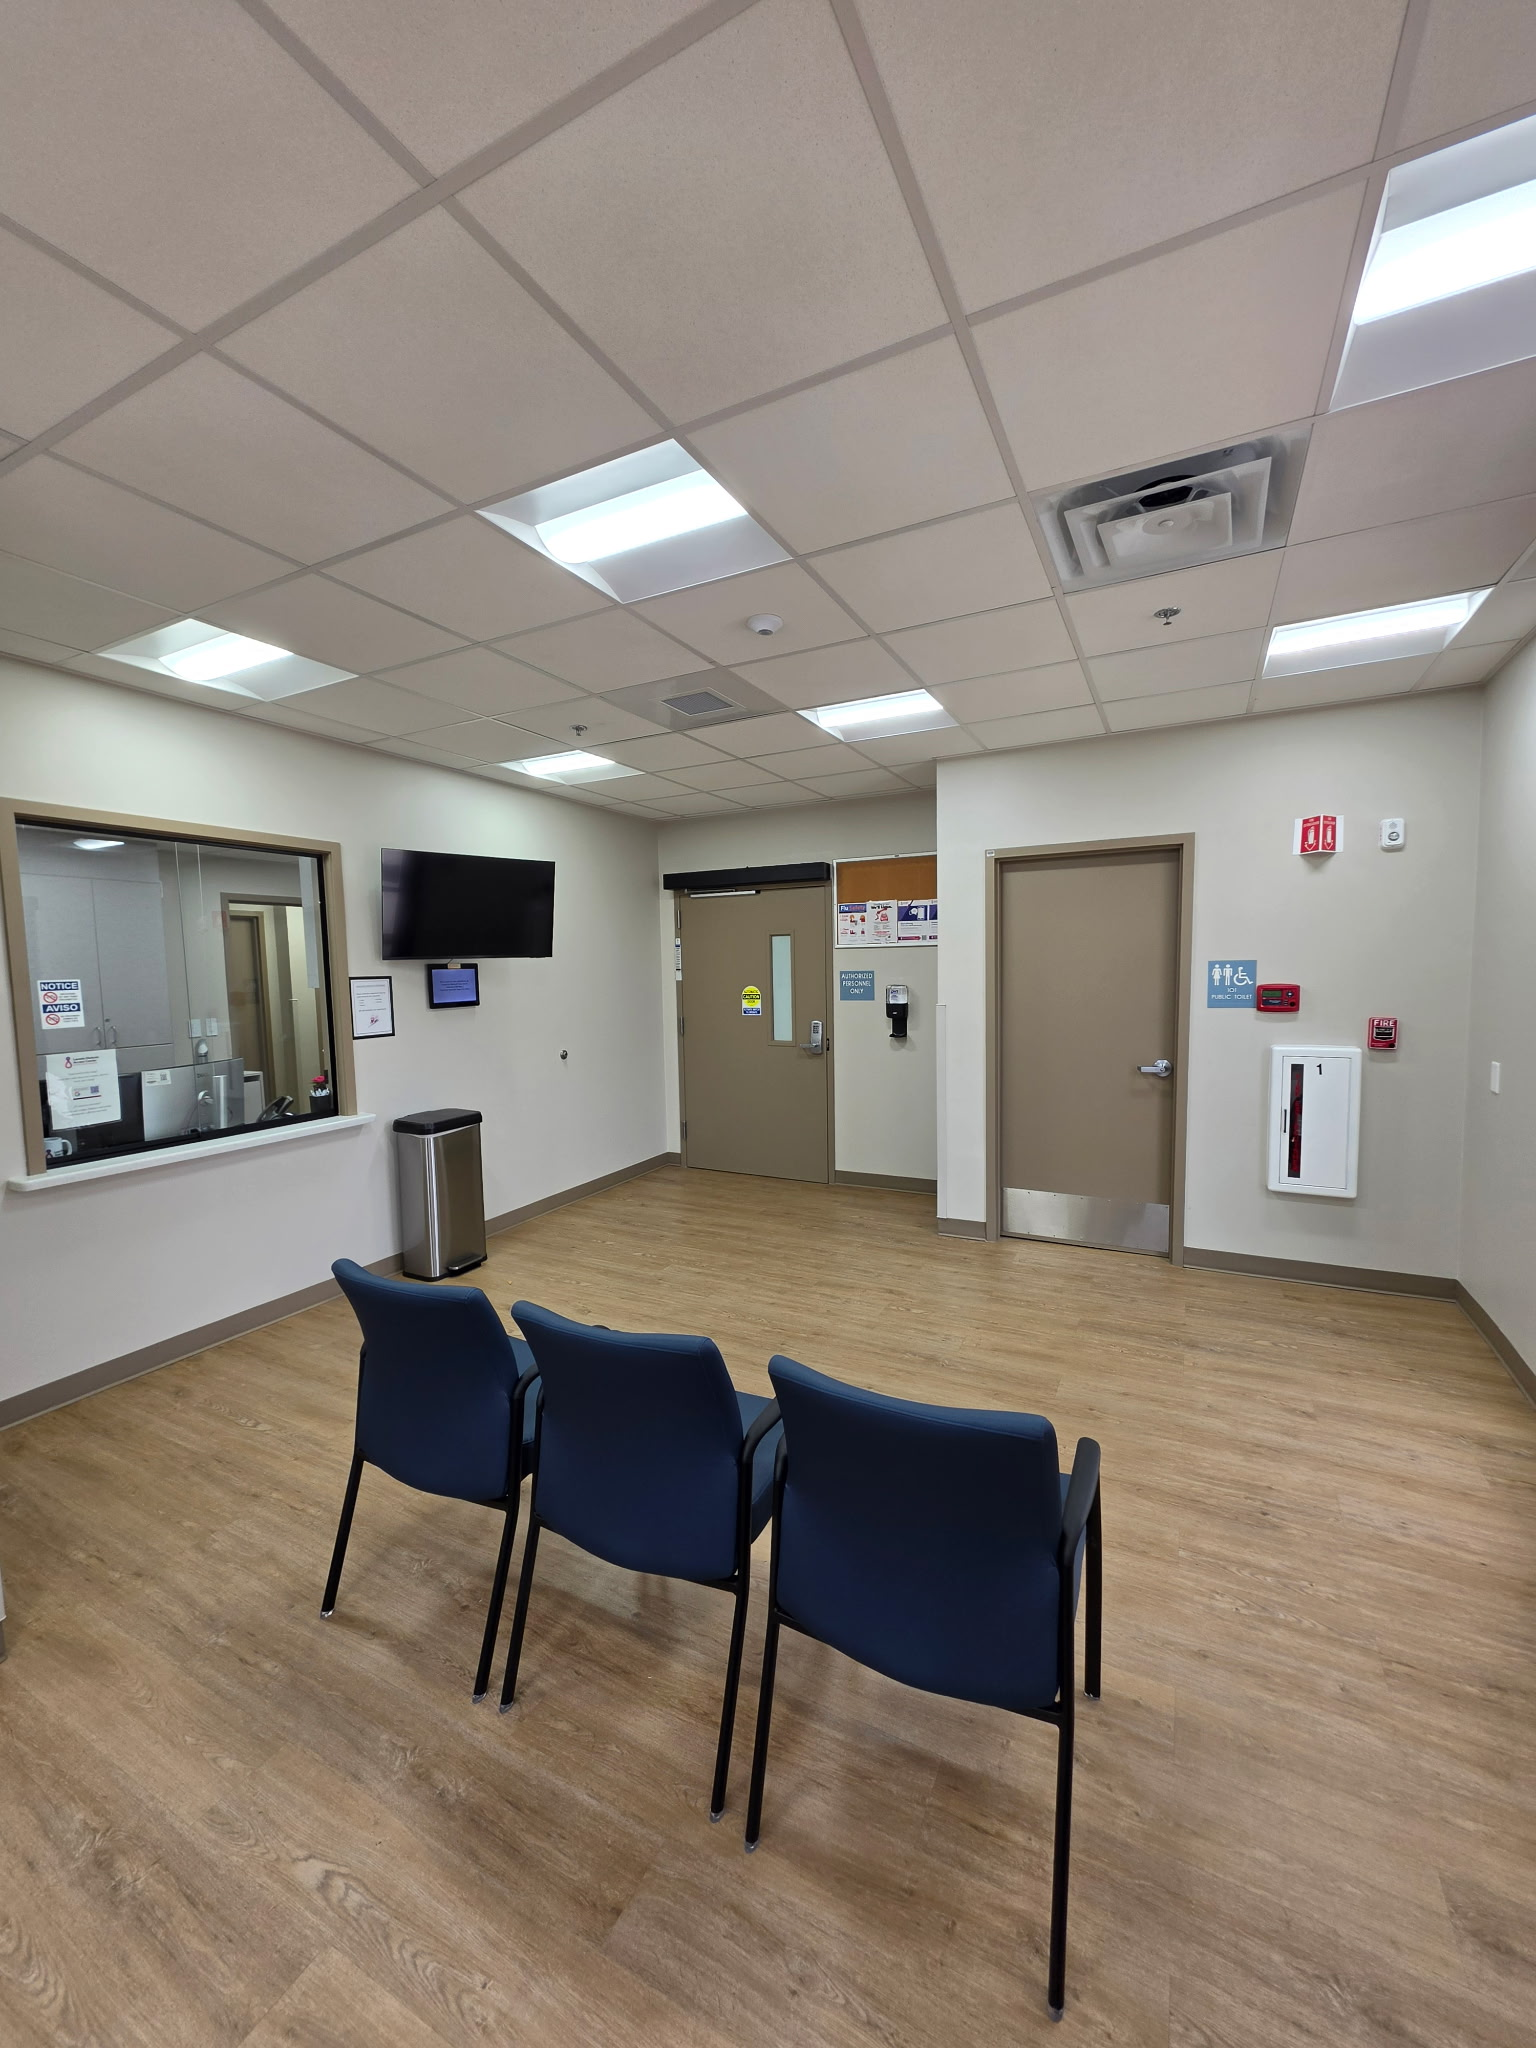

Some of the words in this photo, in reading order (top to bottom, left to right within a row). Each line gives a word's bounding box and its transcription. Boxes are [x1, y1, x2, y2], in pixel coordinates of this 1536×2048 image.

[41, 982, 78, 990] NOTICE
[46, 1004, 79, 1012] AVISO
[1373, 1019, 1396, 1027] FIRE
[1316, 1063, 1323, 1075] 1
